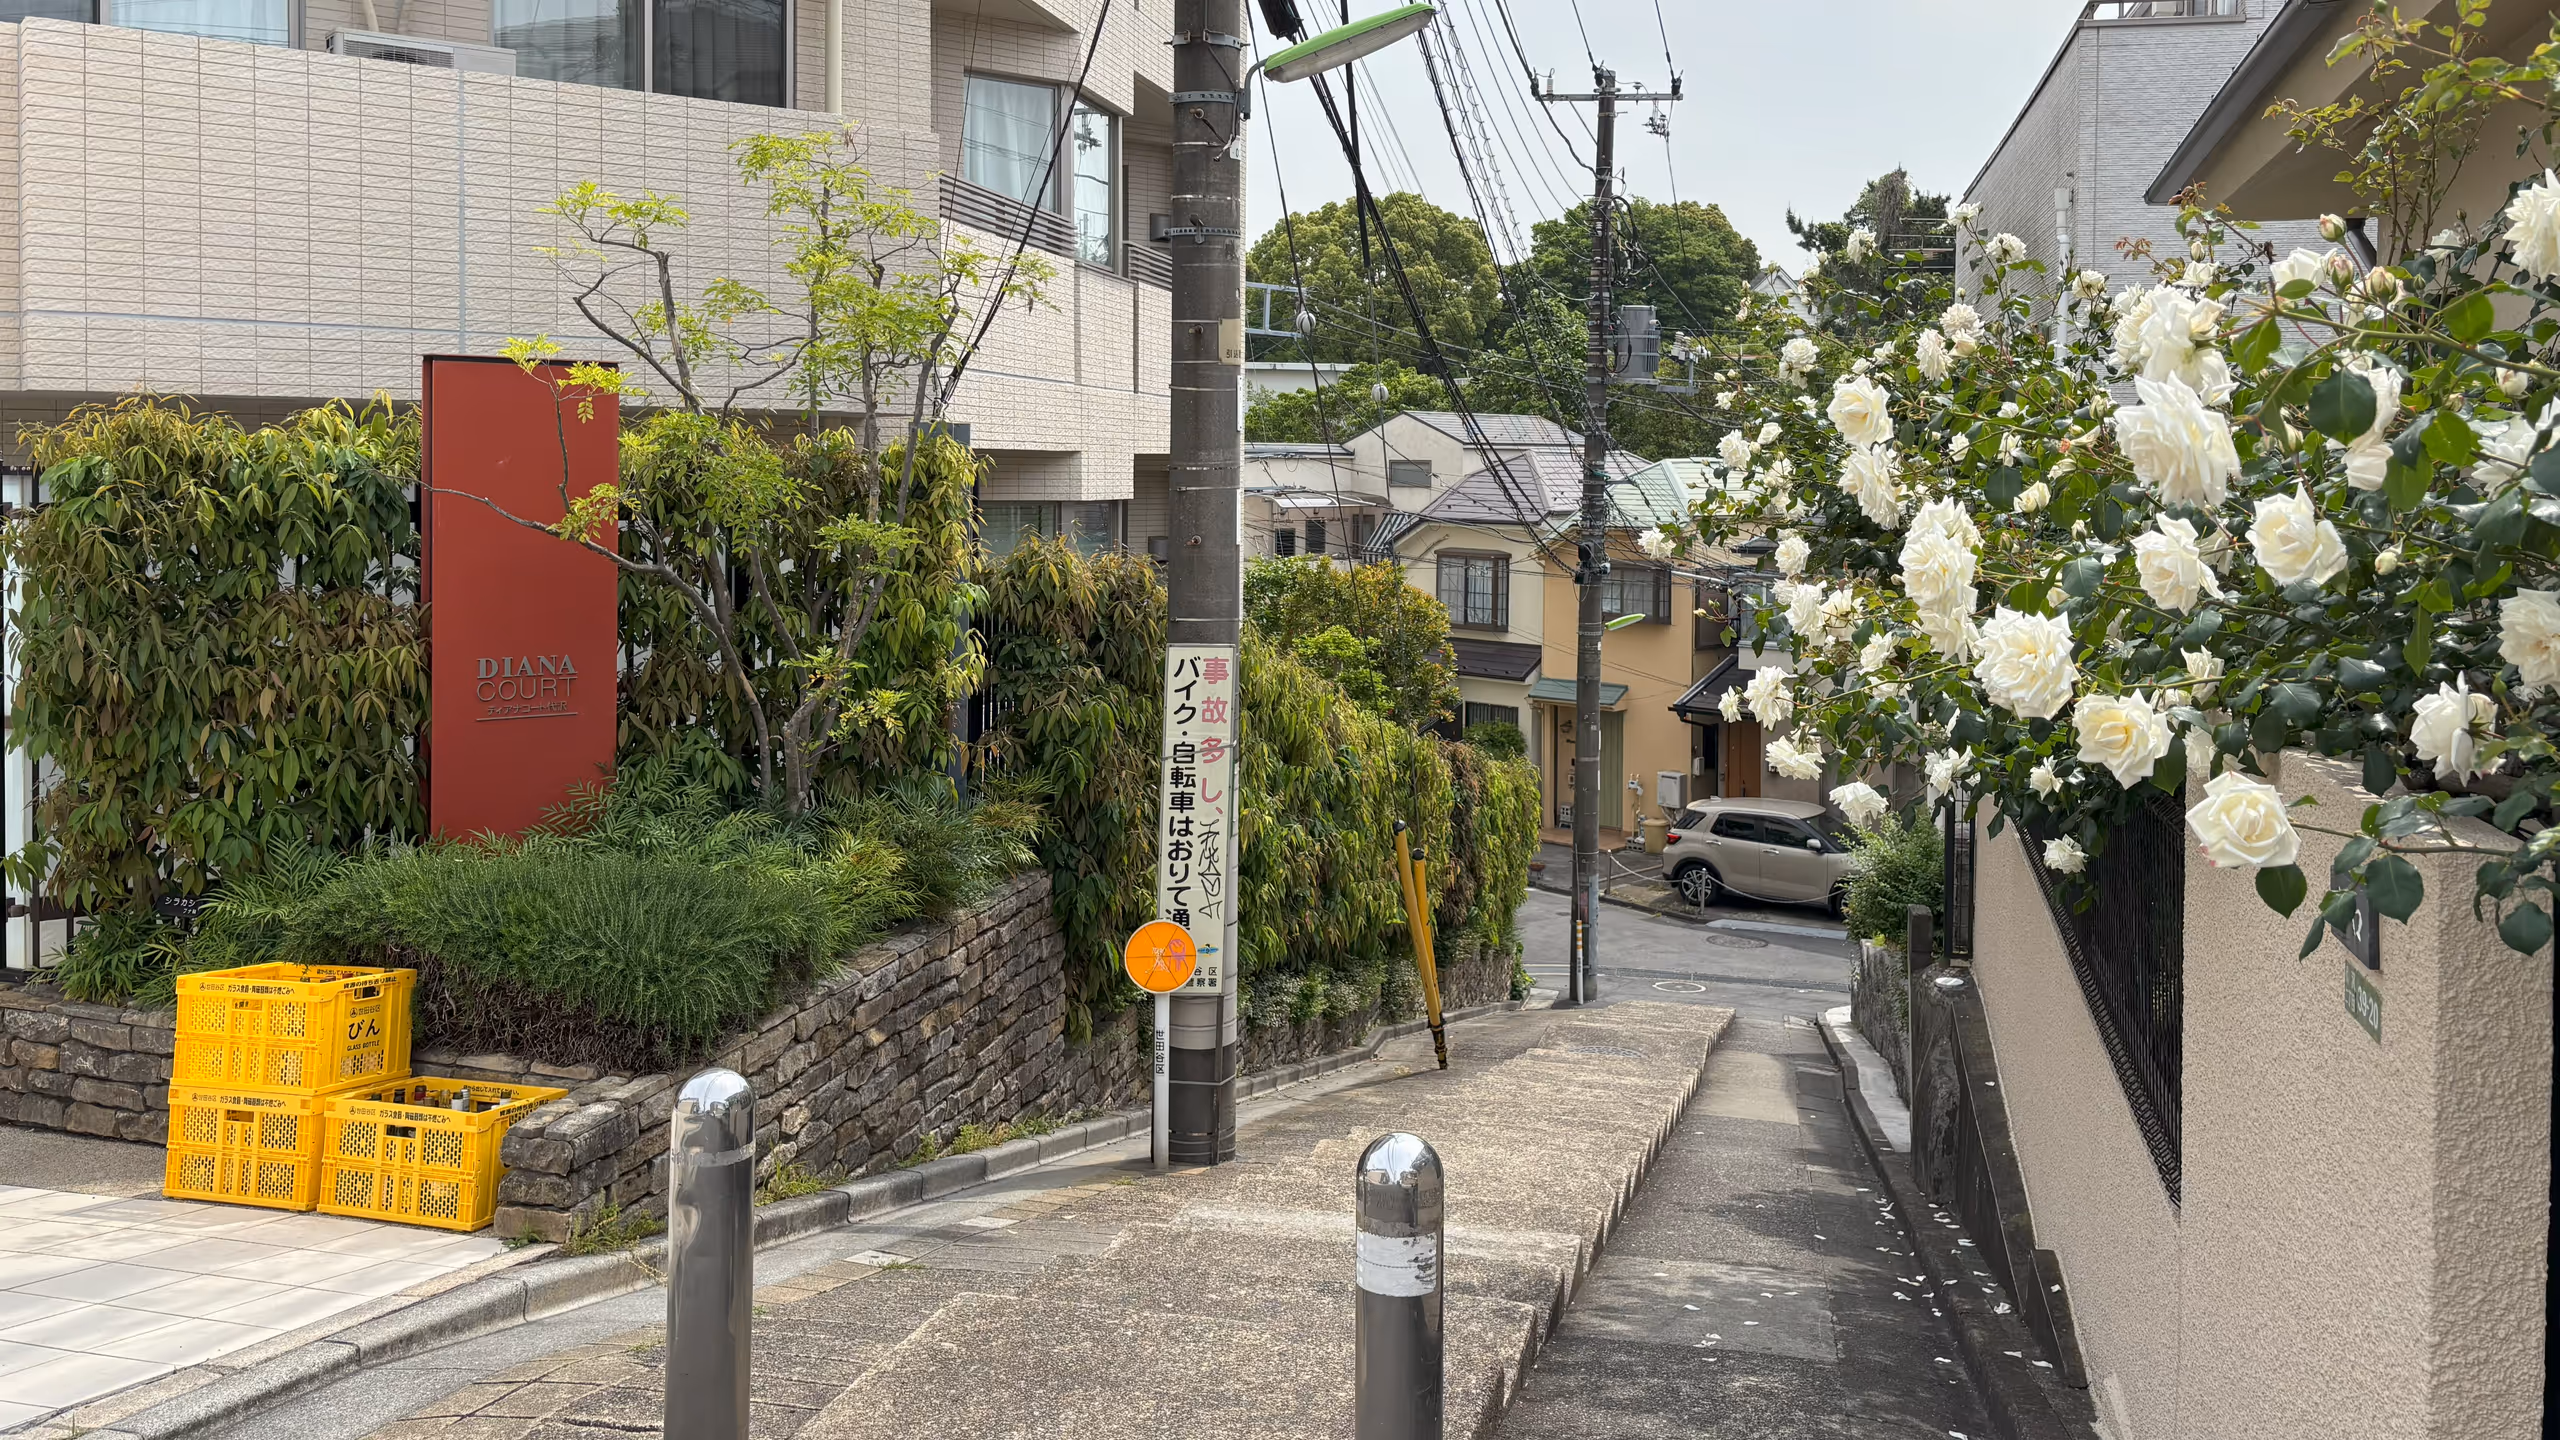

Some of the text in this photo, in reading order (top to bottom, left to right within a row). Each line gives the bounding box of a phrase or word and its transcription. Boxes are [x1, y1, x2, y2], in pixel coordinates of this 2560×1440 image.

[476, 654, 578, 679] DIANA
[476, 677, 578, 702] COURT
[1199, 656, 1230, 814] 事故多し、
[164, 896, 196, 907] シラカシ
[2357, 985, 2379, 1030] 39-20
[348, 1018, 380, 1040] びん
[346, 1040, 380, 1051] GLASS BOTTLE
[1156, 1029, 1165, 1074] 世田谷区
